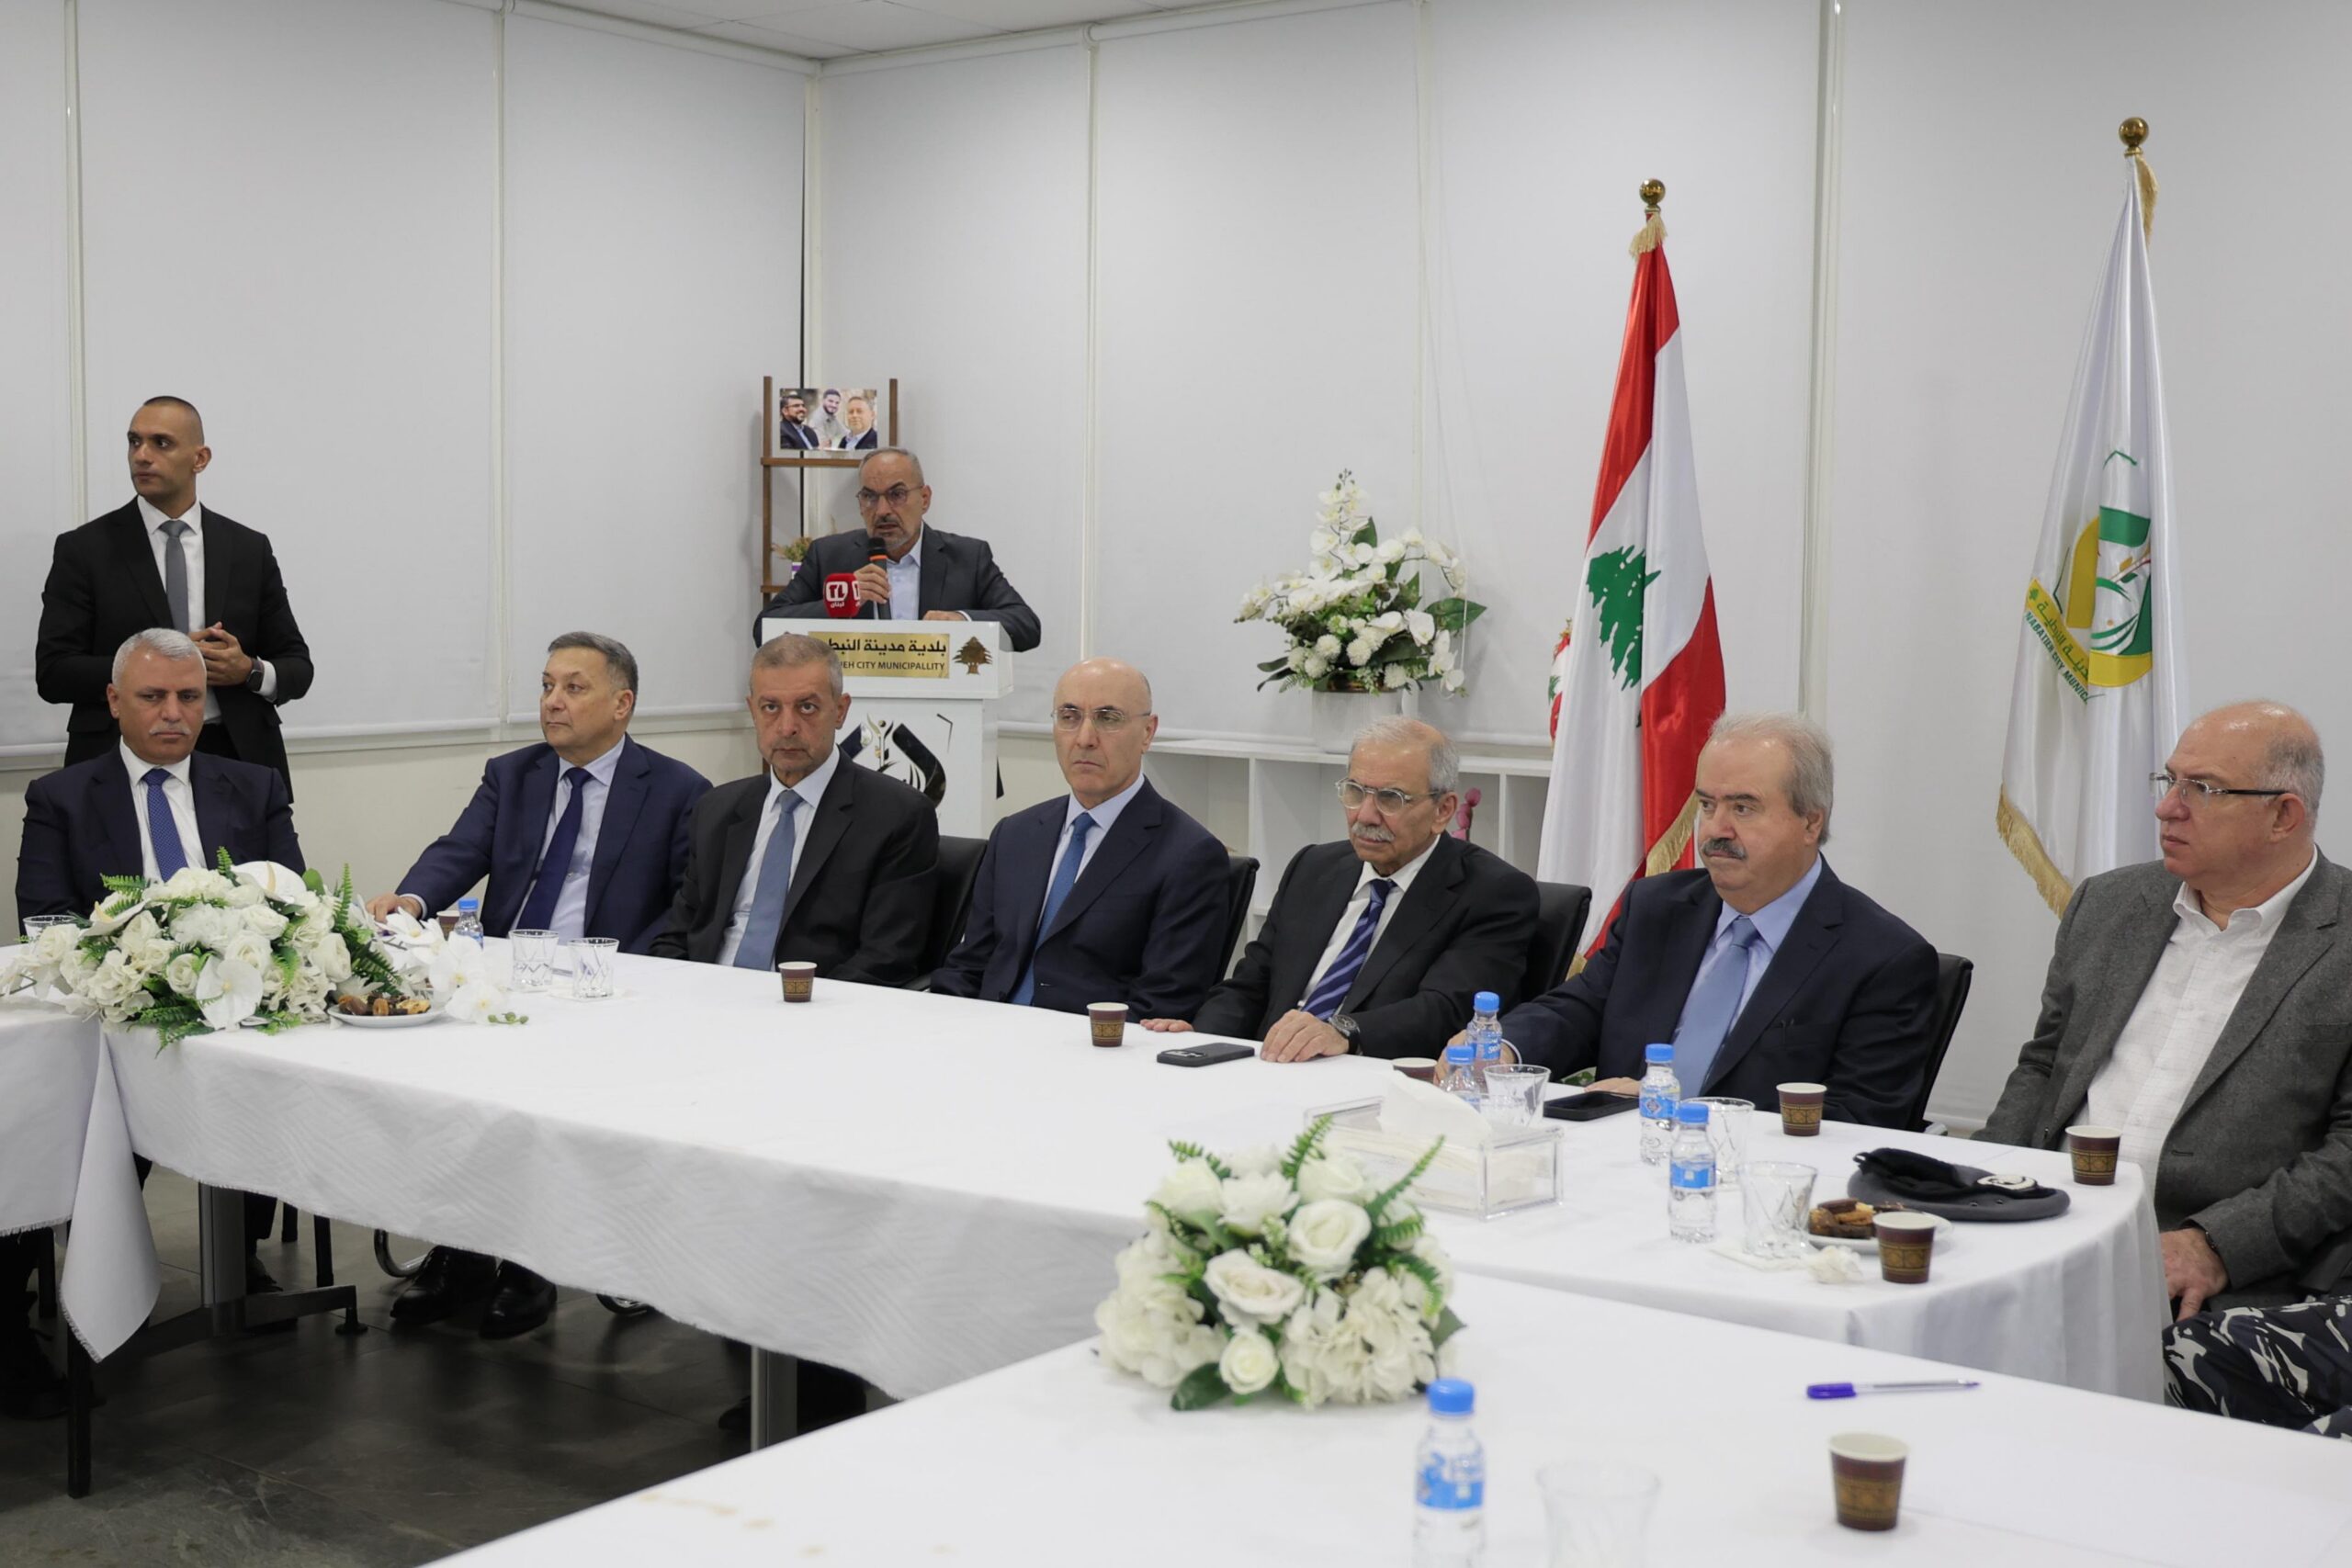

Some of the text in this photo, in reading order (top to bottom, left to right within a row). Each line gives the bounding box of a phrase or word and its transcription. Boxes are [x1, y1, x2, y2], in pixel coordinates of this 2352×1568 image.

[829, 637, 946, 657] بلدية مدينة النبط
[2025, 611, 2054, 653] NABATIEH
[2052, 651, 2064, 670] CITY
[856, 661, 876, 670] CITY
[877, 661, 945, 671] MUNICIPALLITY
